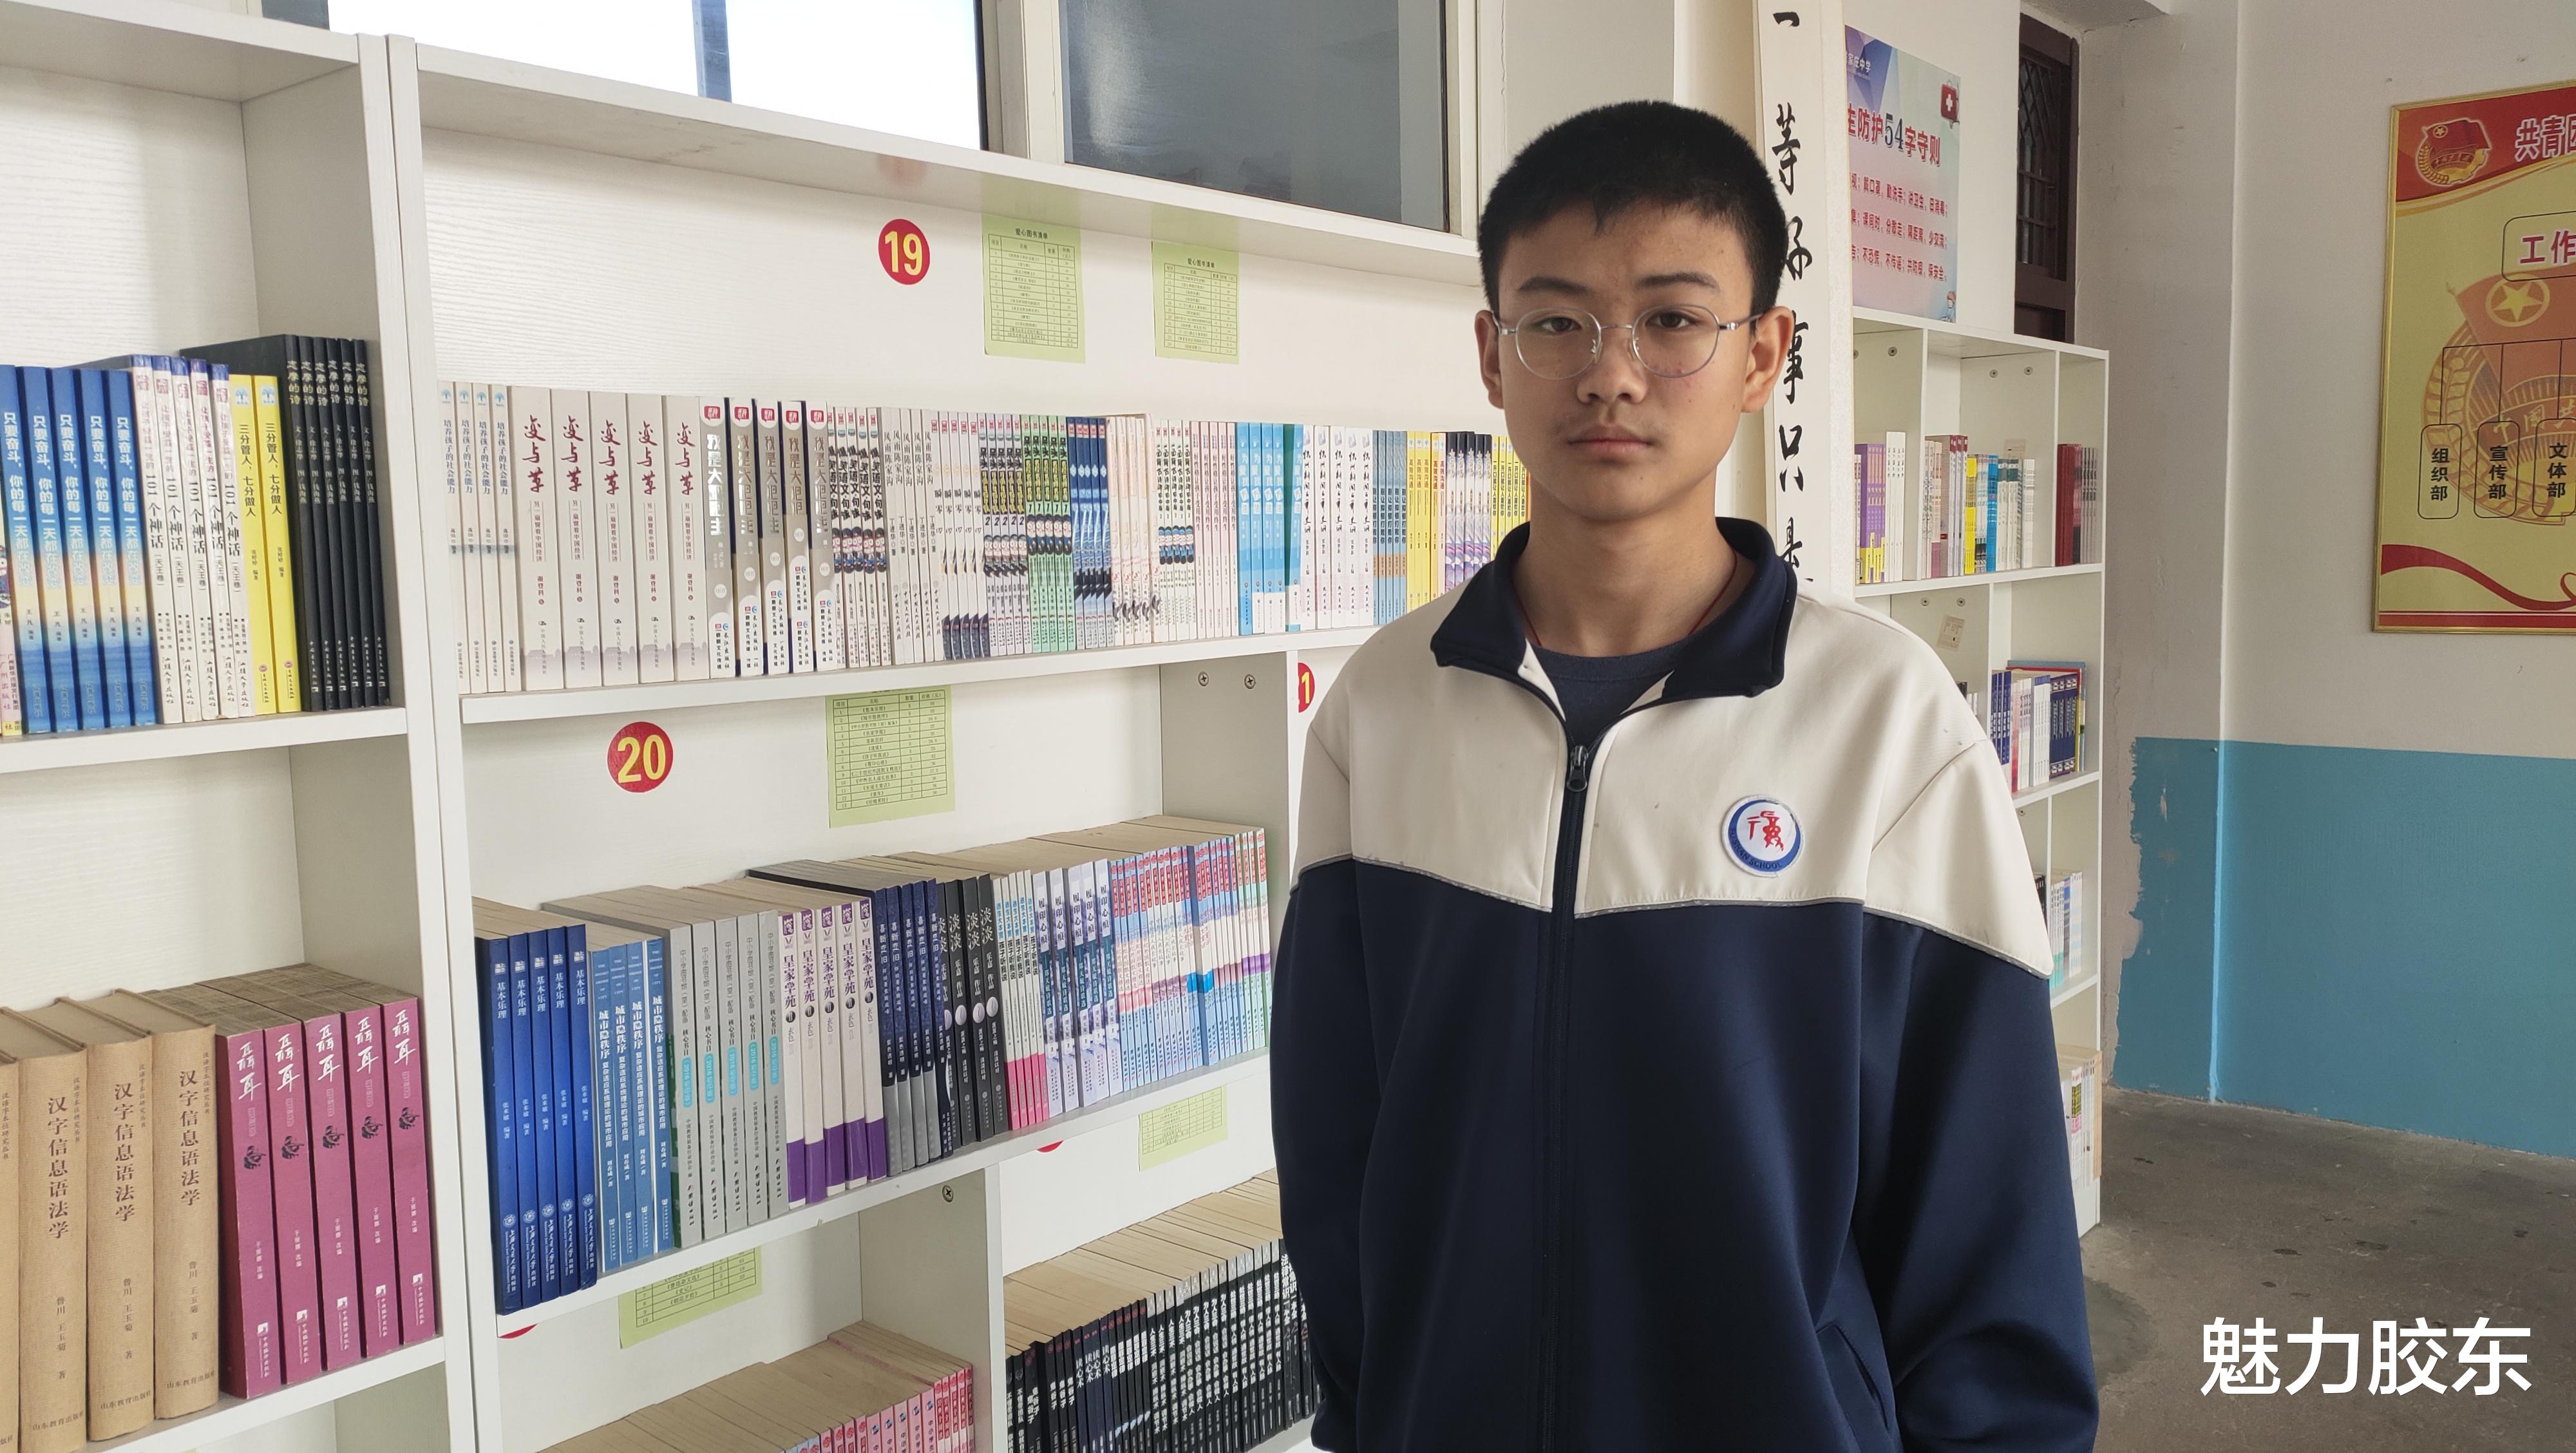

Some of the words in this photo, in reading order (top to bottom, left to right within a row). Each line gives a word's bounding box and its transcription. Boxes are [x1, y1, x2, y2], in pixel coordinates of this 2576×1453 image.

[884, 231, 923, 276] 19
[287, 361, 301, 406] 志摩的诗
[301, 361, 316, 406] 志摩的诗
[314, 362, 328, 407] 志摩的诗
[328, 359, 341, 404] 志摩的诗
[342, 361, 355, 406] 志摩的诗
[355, 362, 370, 406] 志摩的诗
[2430, 448, 2450, 501] 组织部
[2488, 445, 2508, 500] 宣传部
[2546, 442, 2568, 499] 文体部
[985, 516, 990, 526] 2
[617, 734, 666, 783] 20
[1749, 859, 1781, 869] SCHOOL
[949, 913, 962, 953] 淡淡
[966, 912, 981, 951] 淡淡
[980, 907, 995, 945] 淡淡
[822, 945, 835, 1001] 皇家学苑
[842, 942, 856, 996] 皇家学苑
[862, 937, 875, 991] 皇家学苑
[998, 941, 1008, 982] 孩子听我说
[1007, 940, 1016, 980] 孩子听我说
[1016, 938, 1024, 978] 孩子听我说
[1023, 935, 1031, 975] 孩子听我说
[1030, 935, 1039, 976] 孩子听我说
[516, 979, 527, 1016] 基本乐理
[536, 976, 547, 1012] 基本乐理
[554, 972, 565, 1009] 基本乐理
[576, 969, 586, 1005] 基本乐理
[783, 954, 797, 1010] 皇家学苑
[802, 949, 815, 1005] 皇家学苑
[956, 980, 963, 998] 作品
[974, 979, 981, 996] 作品
[987, 973, 995, 990] 作品
[497, 982, 507, 1019] 基本乐理
[652, 995, 664, 1043] 城市隐秩序
[598, 1010, 611, 1060] 城市隐秩序
[614, 1005, 627, 1055] 城市隐秩序
[632, 1001, 644, 1050] 城市隐秩序
[113, 1082, 135, 1222] 汉字信息语法学
[178, 1070, 200, 1206] 汉字信息语法学
[47, 1096, 70, 1239] 汉字信息语法学
[1075, 1358, 1084, 1389] 读心术
[1084, 1353, 1094, 1383] 读心术
[1092, 1349, 1101, 1380] 读心术
[1102, 1344, 1110, 1375] 读心术
[1027, 1394, 1035, 1425] 鬼谷子
[1032, 1386, 1040, 1416] 鬼谷子
